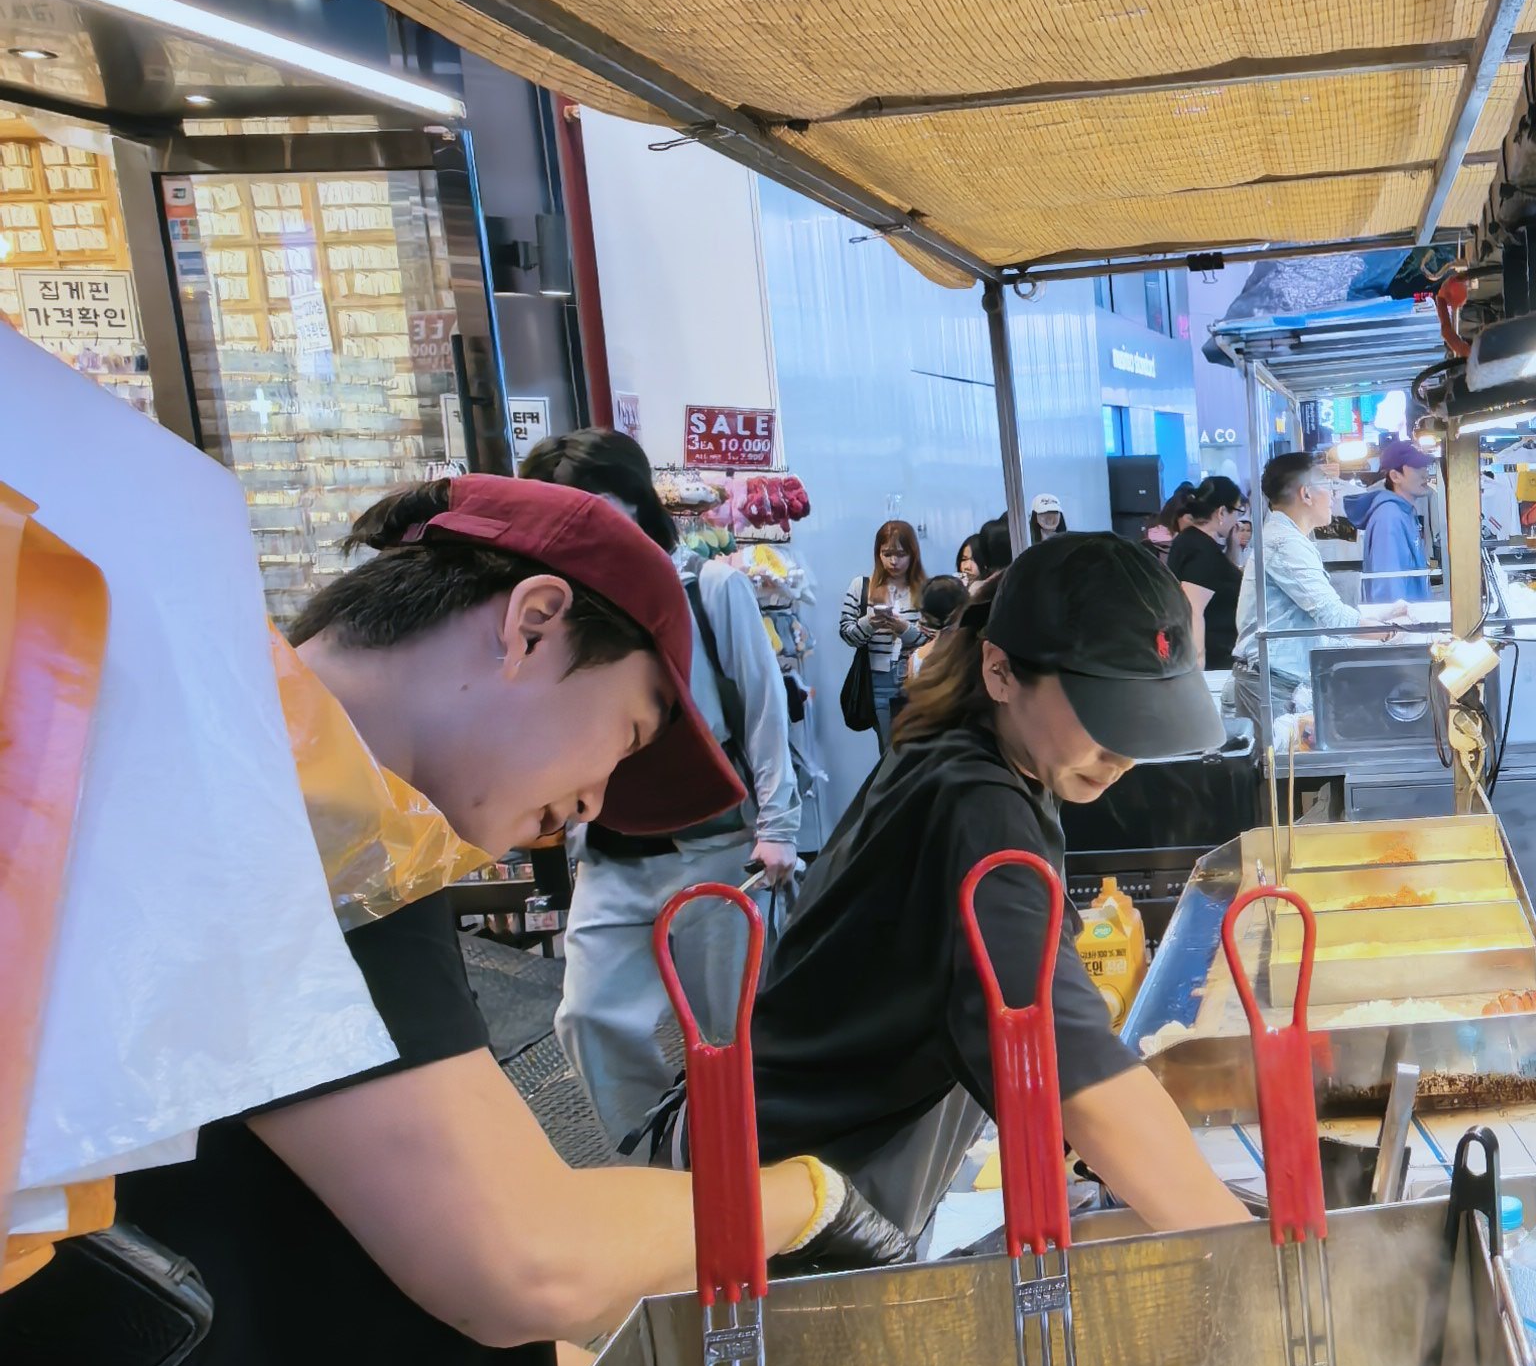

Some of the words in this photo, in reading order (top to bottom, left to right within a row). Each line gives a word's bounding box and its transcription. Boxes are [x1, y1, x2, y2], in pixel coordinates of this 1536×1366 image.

[38, 280, 110, 302] 집게핀
[28, 306, 127, 328] 가격확인
[690, 412, 769, 436] SALE
[687, 434, 715, 451] 3EA
